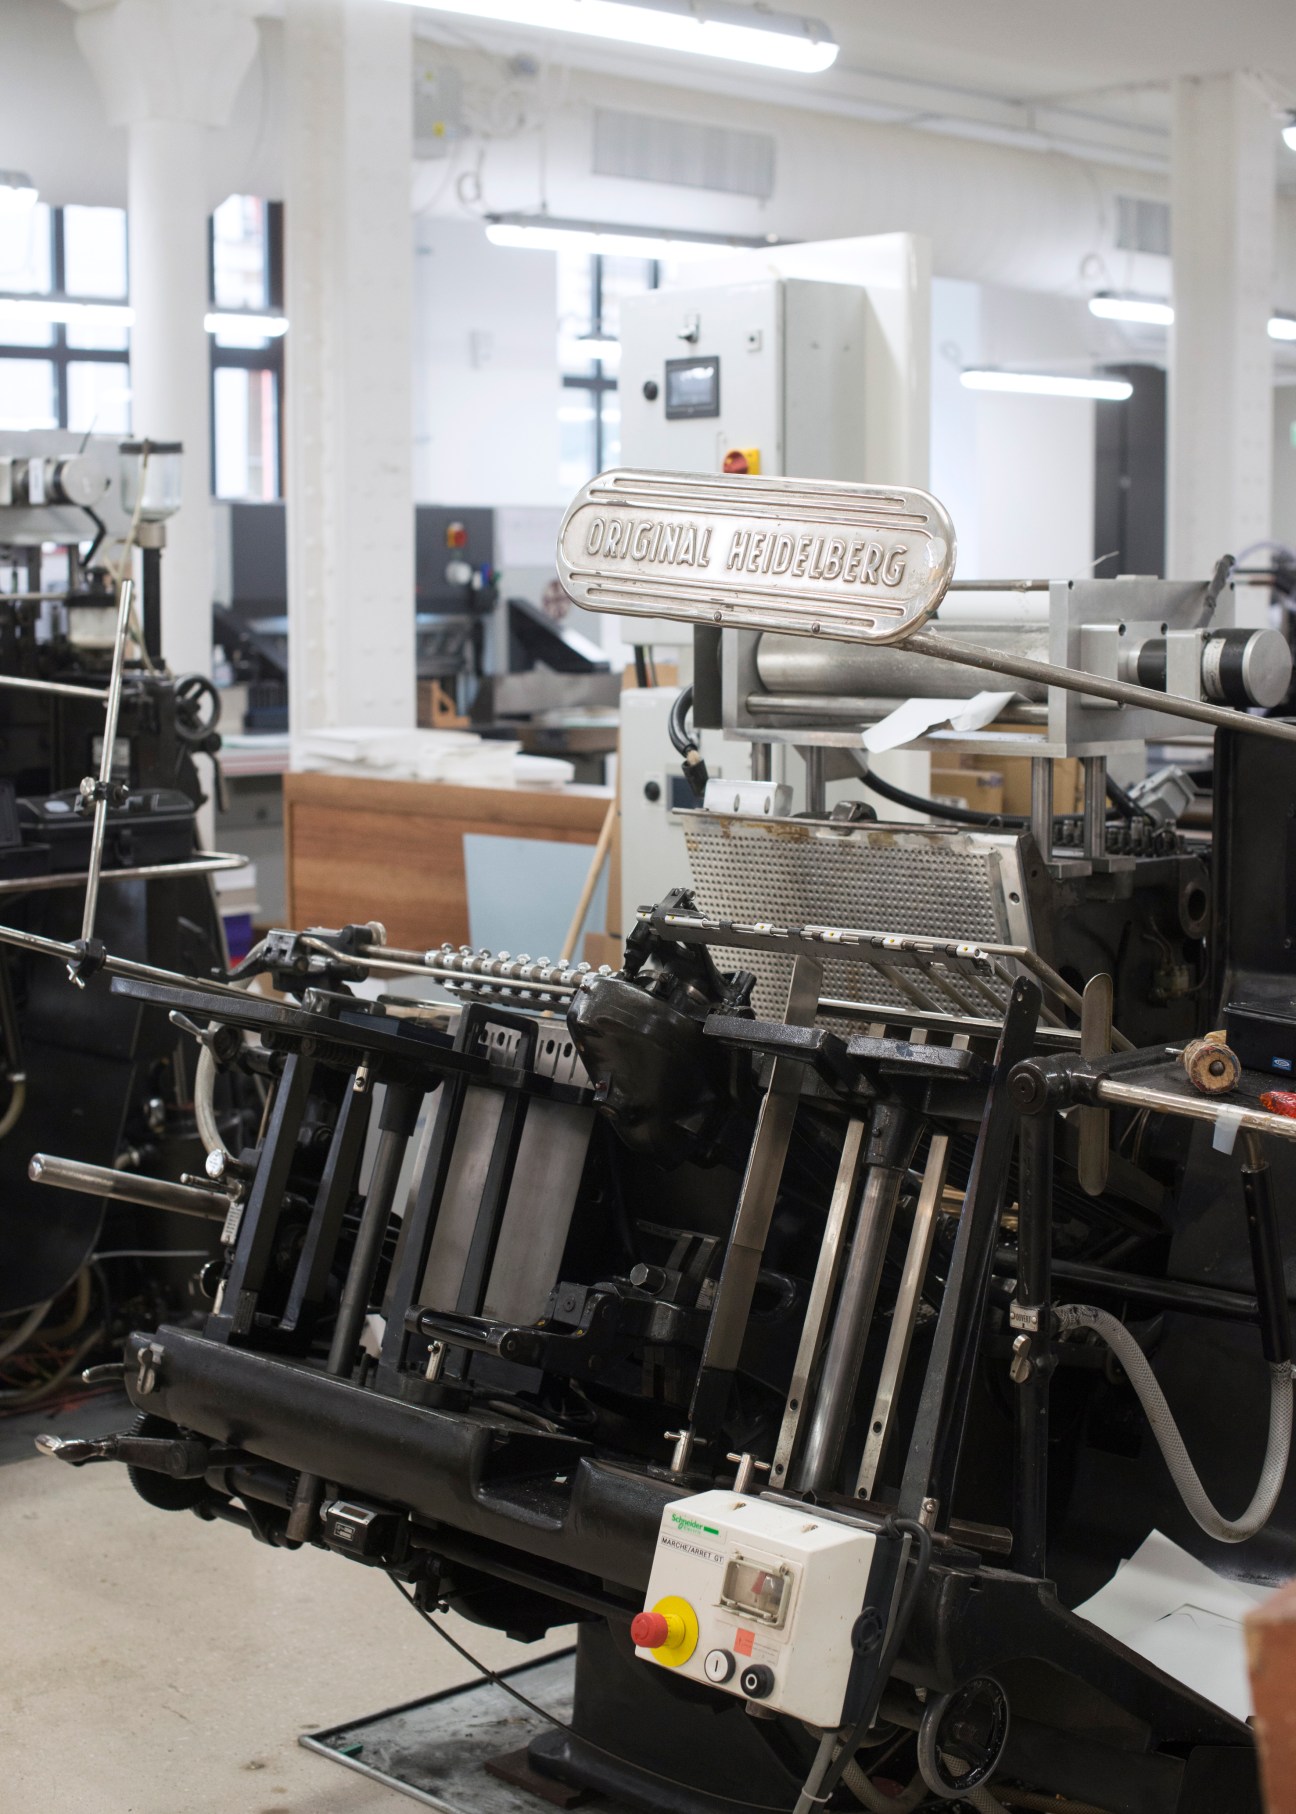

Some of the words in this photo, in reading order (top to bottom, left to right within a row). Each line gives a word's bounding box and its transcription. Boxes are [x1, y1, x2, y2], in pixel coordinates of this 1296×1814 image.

[586, 517, 713, 567] ORIGINAL
[727, 530, 909, 587] HEIDELBERG
[671, 1513, 703, 1530] Schneider
[662, 1537, 711, 1558] MARCHE/ARRET
[714, 1555, 725, 1563] GT
